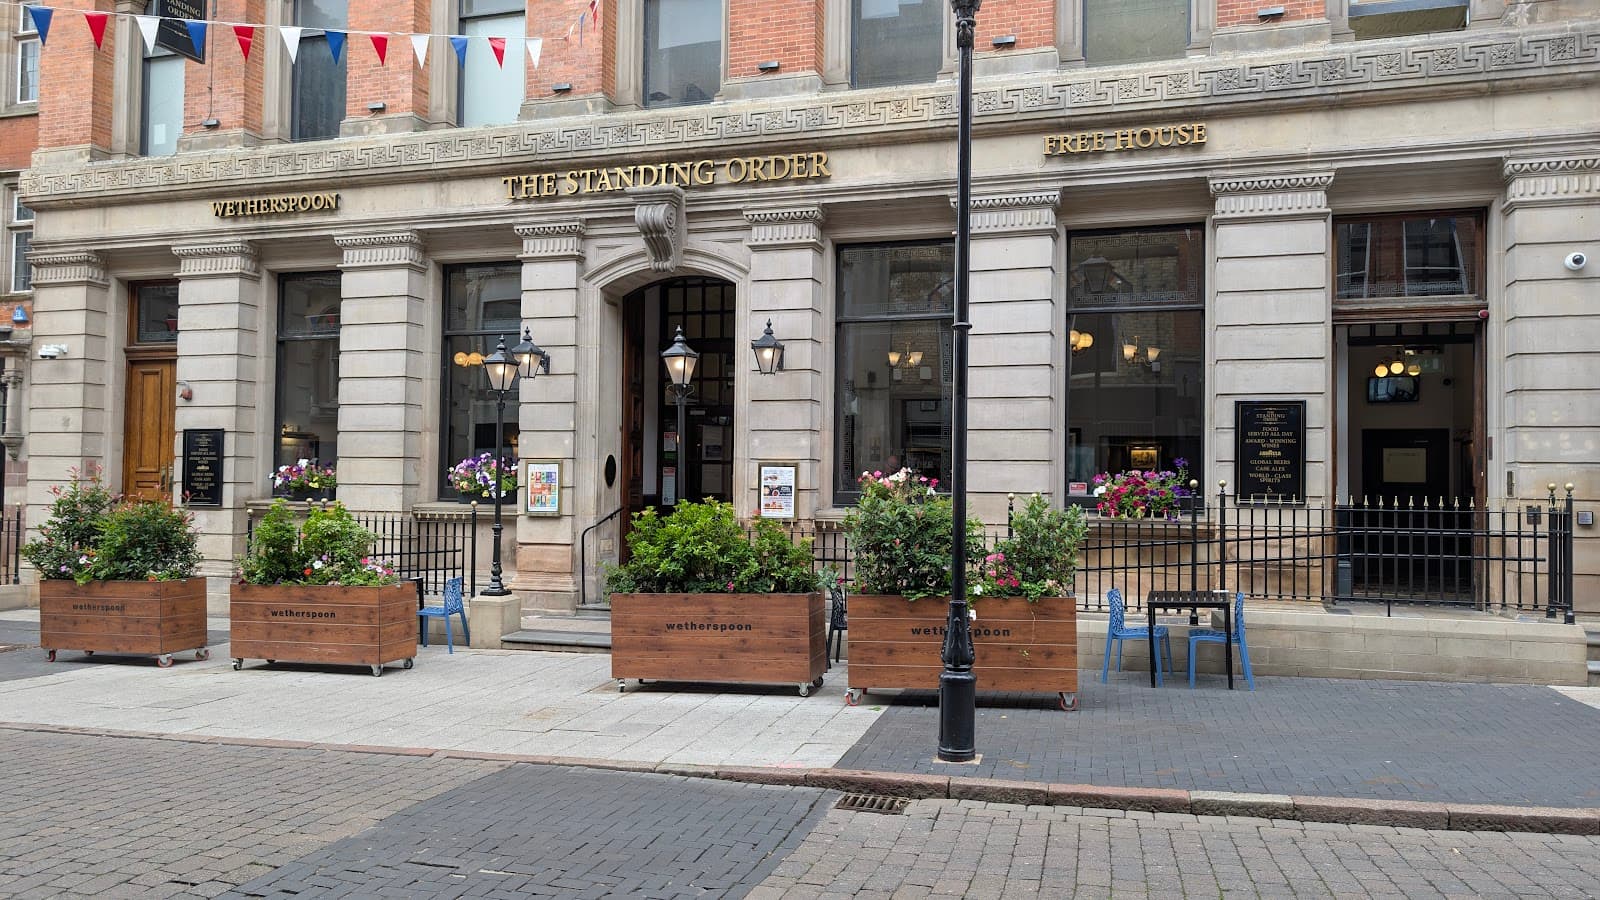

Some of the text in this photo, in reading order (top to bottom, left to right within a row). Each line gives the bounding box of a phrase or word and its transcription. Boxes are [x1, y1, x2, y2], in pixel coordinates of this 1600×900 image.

[168, 0, 201, 17] ANDING
[1043, 123, 1208, 155] FREE HOUSE
[502, 151, 832, 199] THE STANDING ORDER
[209, 192, 340, 217] WETHERSPOON
[271, 609, 336, 619] wetherspoon
[666, 621, 752, 632] wetherspoon
[911, 626, 1010, 637] wethpoon
